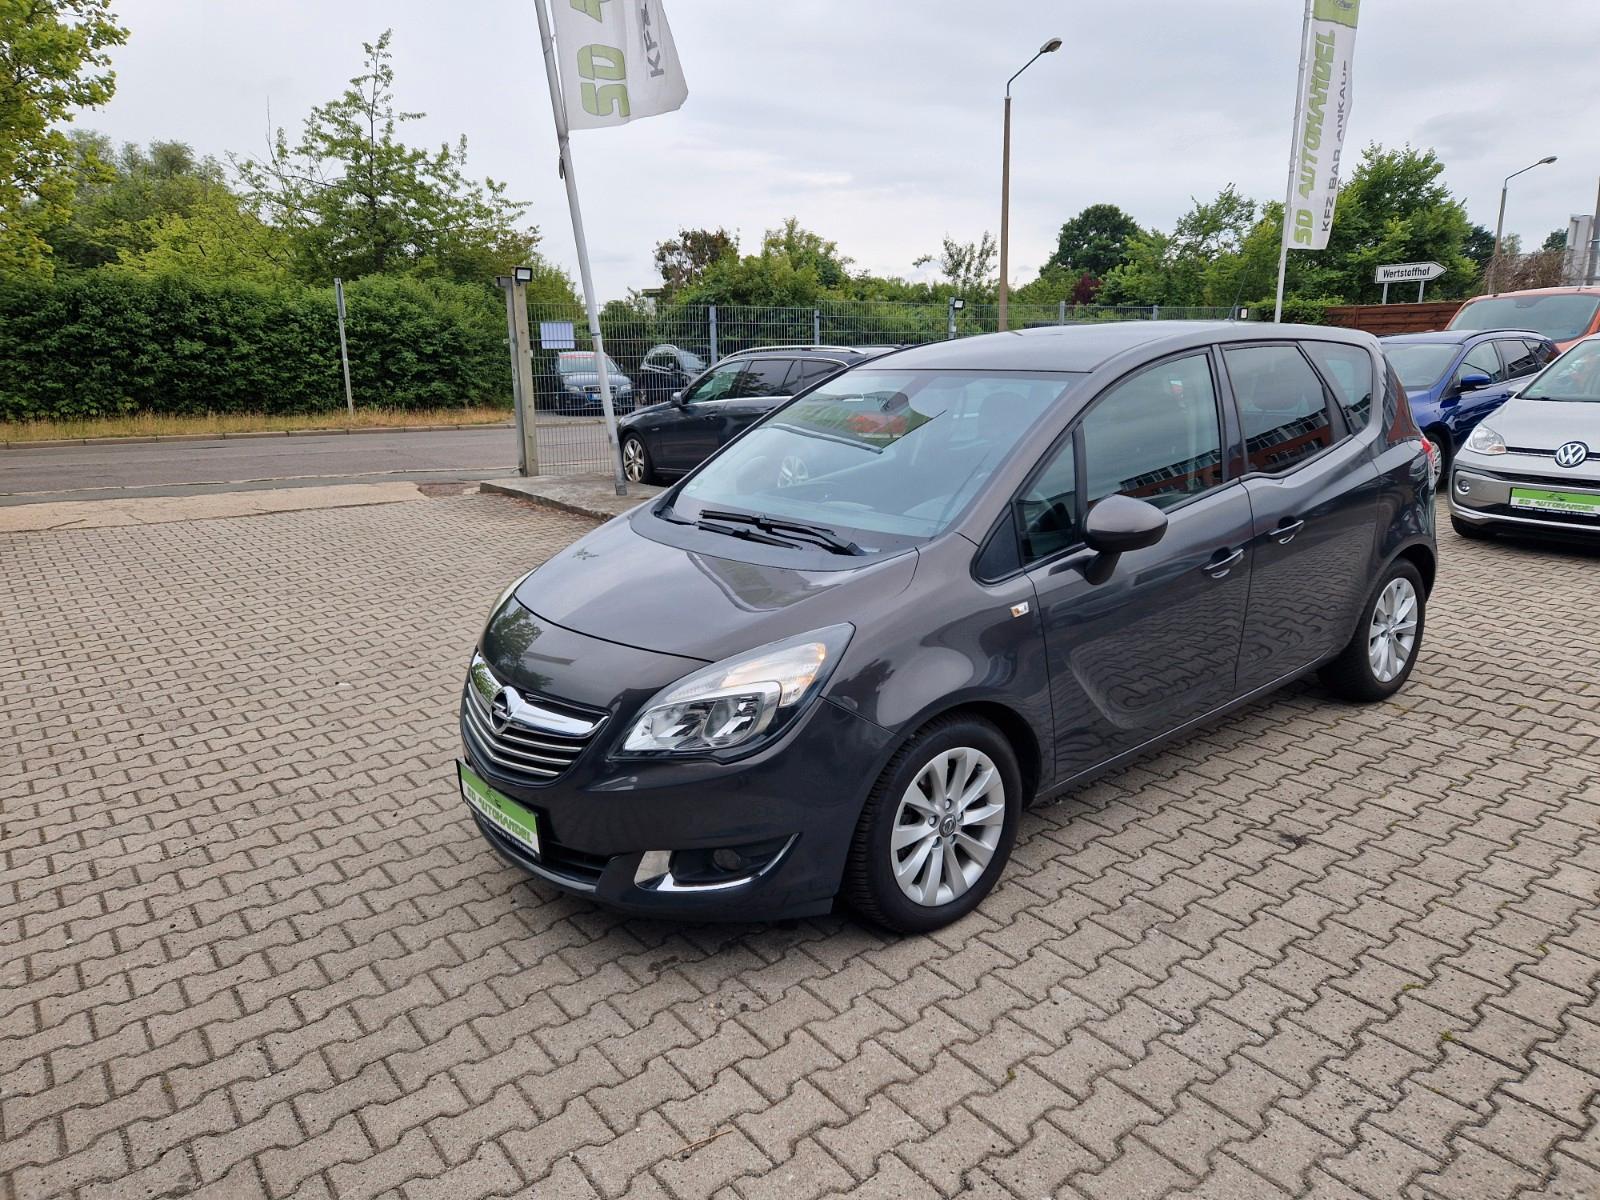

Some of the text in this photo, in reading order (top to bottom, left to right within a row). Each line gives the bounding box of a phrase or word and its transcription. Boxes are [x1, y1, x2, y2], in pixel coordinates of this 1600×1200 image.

[577, 43, 630, 117] SD
[1294, 30, 1336, 246] SD AUTOHANDEL
[1321, 196, 1334, 232] KFZ
[1328, 149, 1341, 190] BAR
[1383, 266, 1430, 279] Wertstoffhof
